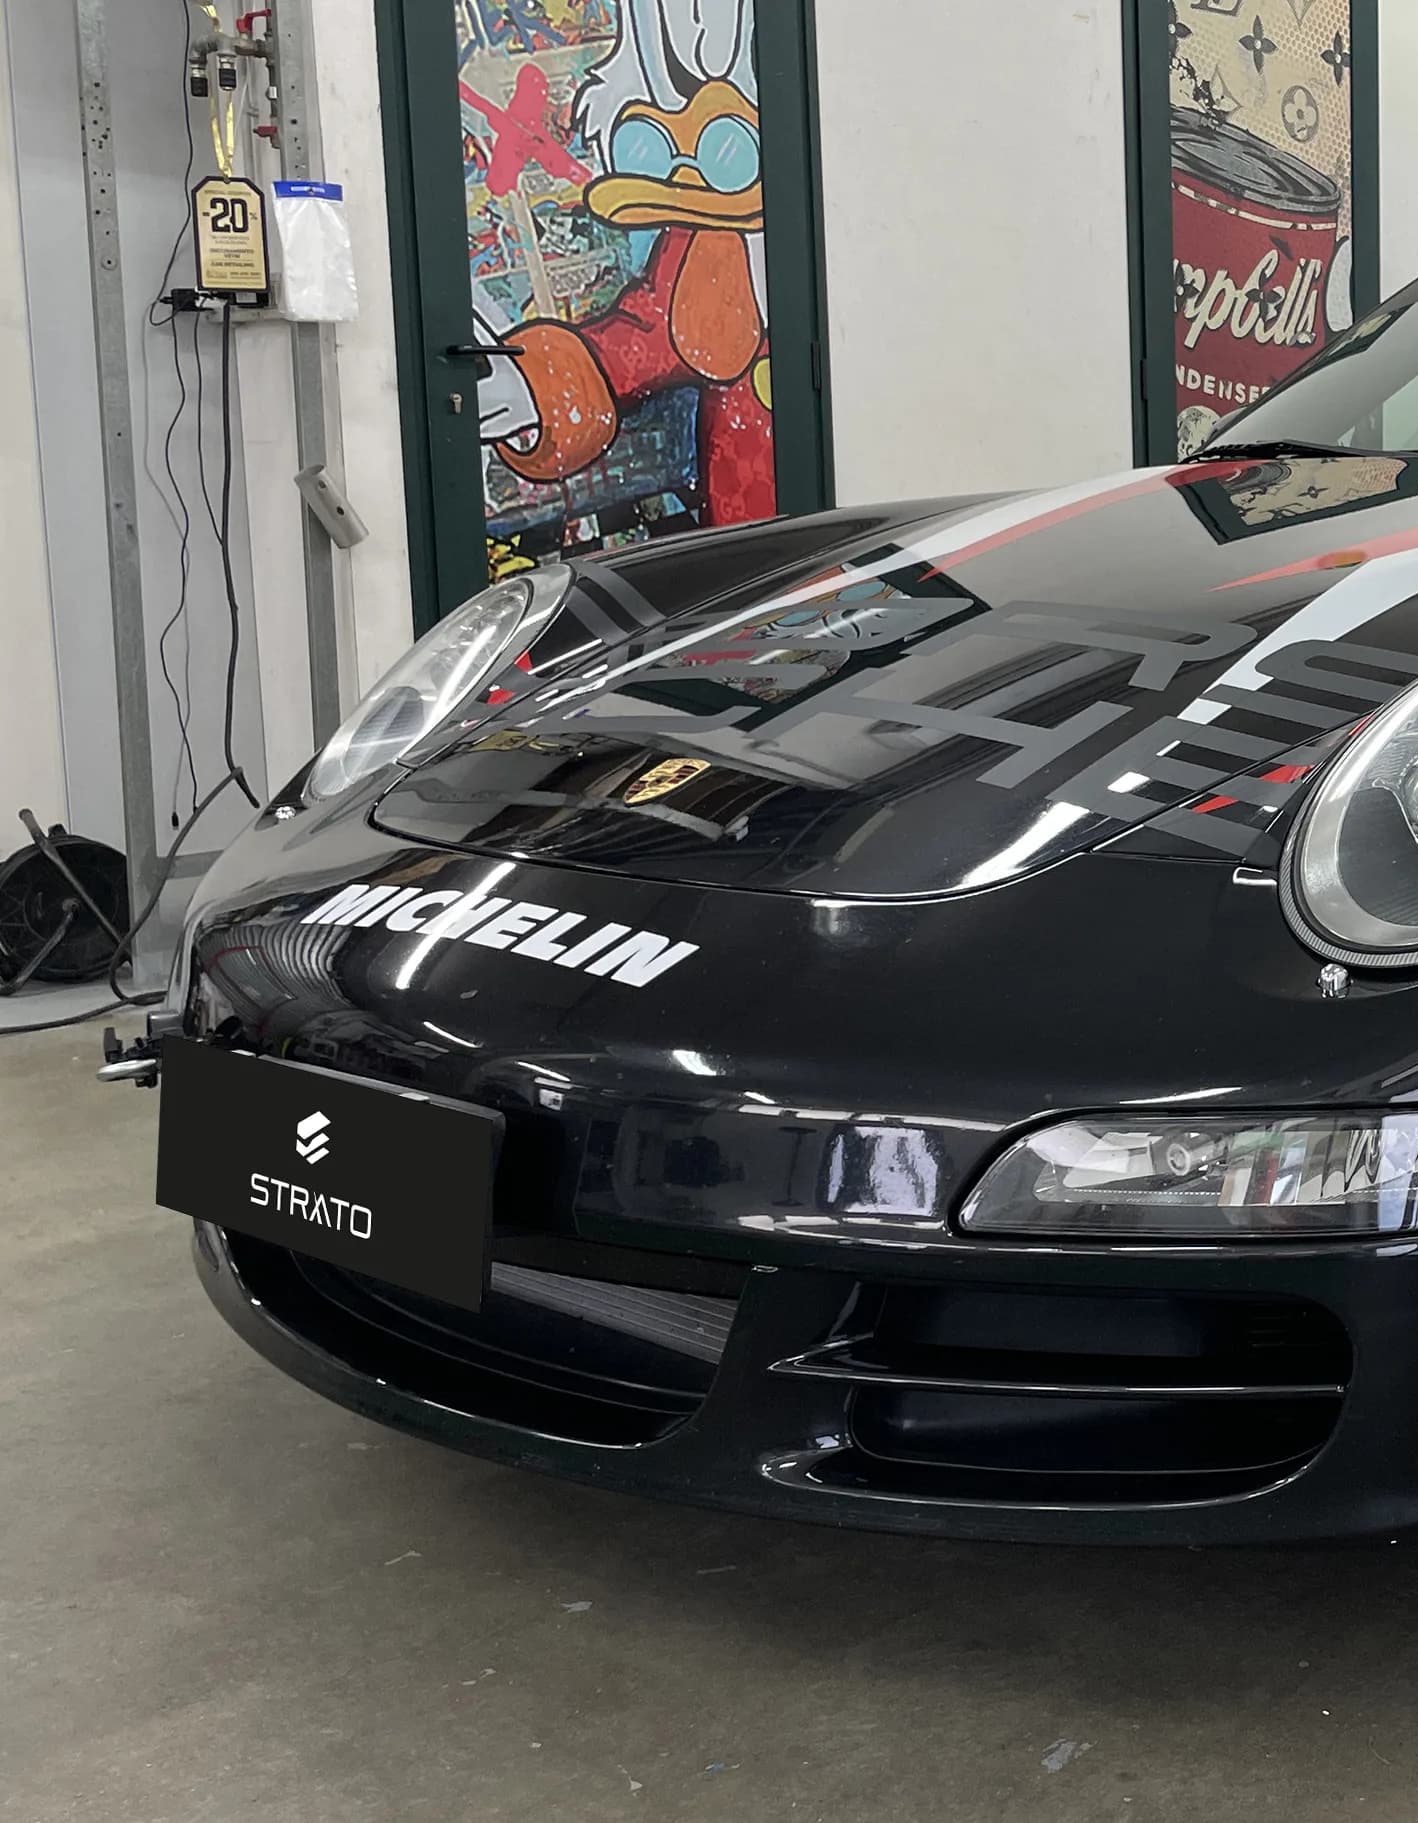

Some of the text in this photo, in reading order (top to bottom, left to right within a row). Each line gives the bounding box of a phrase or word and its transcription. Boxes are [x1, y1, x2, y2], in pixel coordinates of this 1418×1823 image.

[1175, 364, 1272, 405] NDENSE
[301, 884, 700, 988] MICHELIN
[250, 1173, 373, 1241] STRATO
